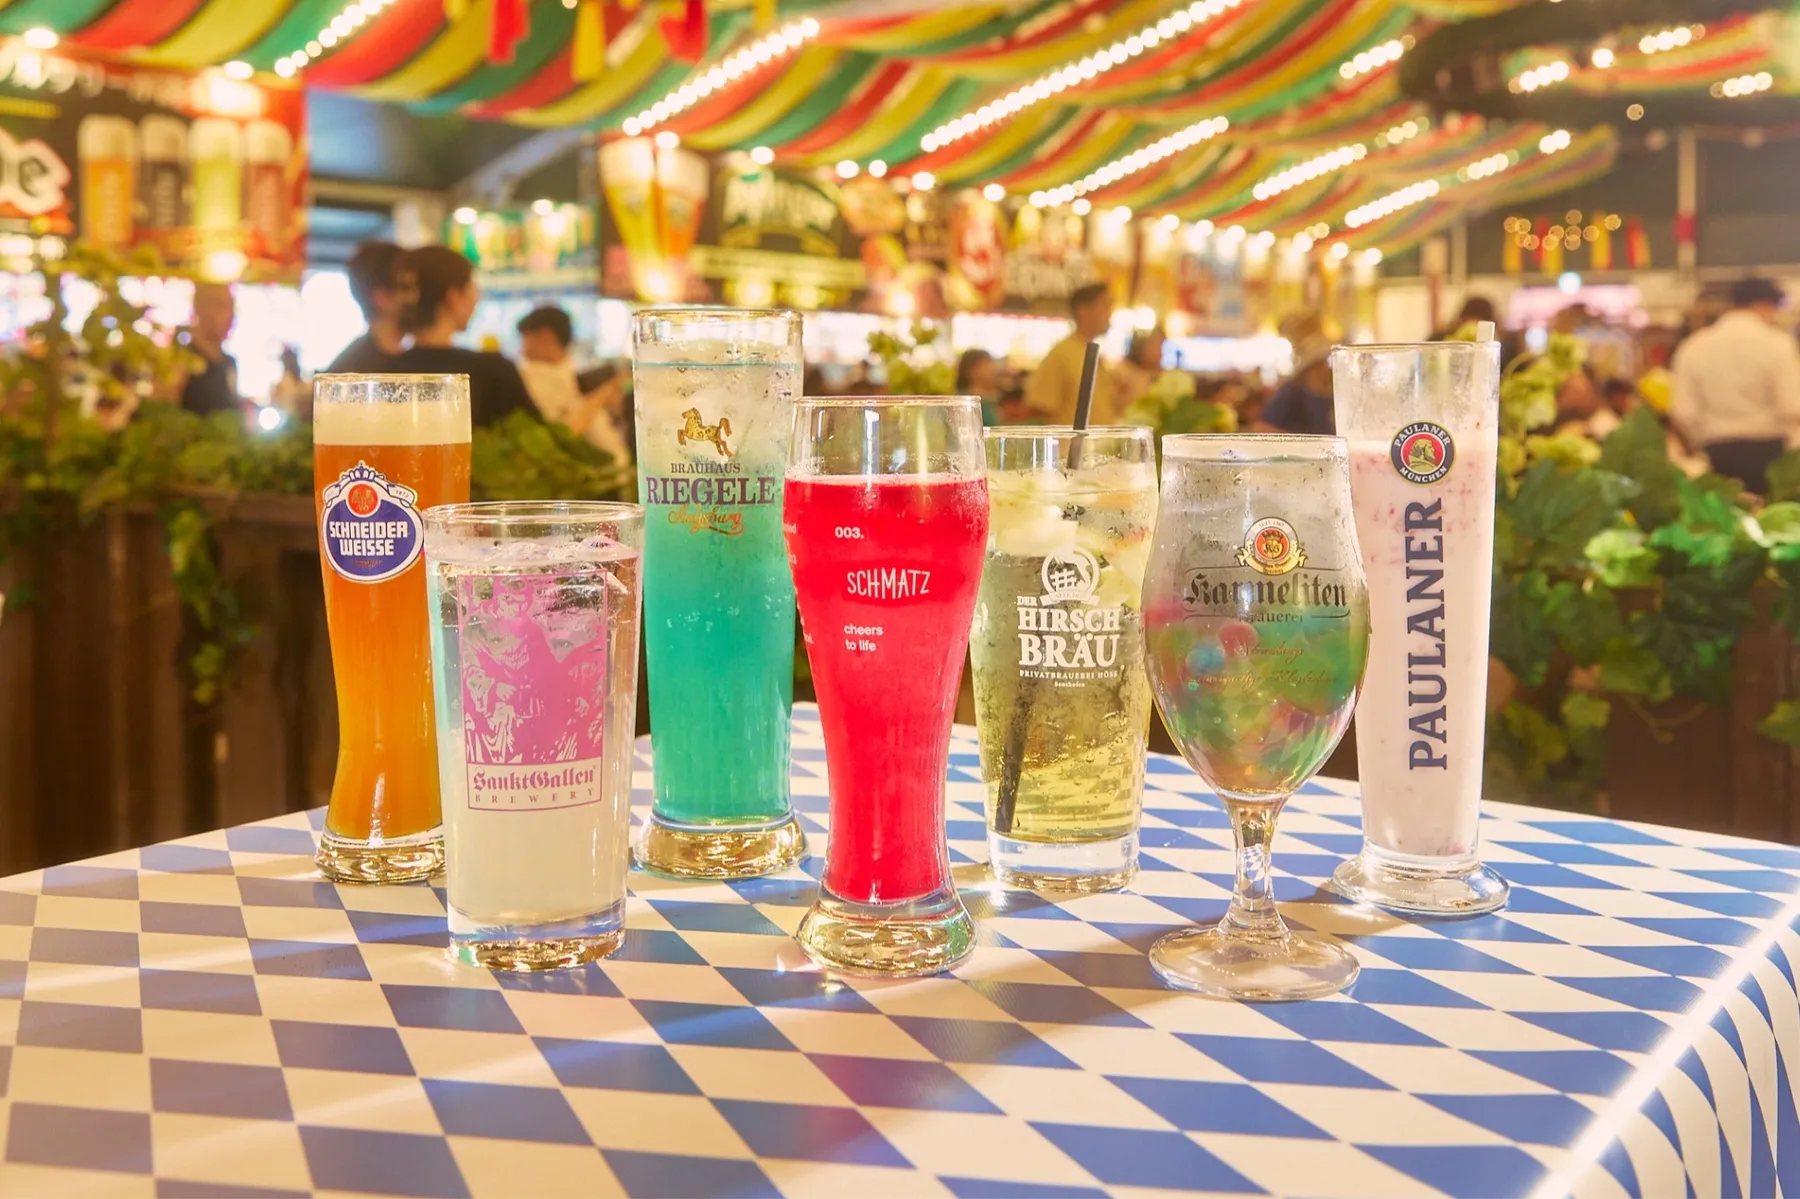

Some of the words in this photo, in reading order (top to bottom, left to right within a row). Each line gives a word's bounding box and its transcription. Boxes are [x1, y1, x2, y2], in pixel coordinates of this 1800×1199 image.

[1394, 423, 1452, 448] PAULANER
[670, 462, 741, 474] BRAUHAUS
[1399, 466, 1448, 483] MÜNCHEN
[646, 477, 776, 505] RIEGELE
[329, 521, 408, 539] SCHNEIDER
[834, 526, 865, 539] 003.
[340, 539, 395, 557] WEISSE
[847, 567, 931, 600] SCHMATZ
[1183, 573, 1347, 612] Karmeliten
[1016, 595, 1038, 607] DER
[1017, 607, 1121, 632] HIRSCH
[843, 624, 884, 636] cheers
[1404, 497, 1448, 771] PAULANER
[845, 640, 857, 651] to
[858, 639, 877, 652] life
[1018, 633, 1121, 668] BRÄU
[1019, 669, 1095, 680] PRIVATBRAUEREI
[473, 767, 595, 791] SanktGallen
[475, 787, 594, 804] BREWERY
